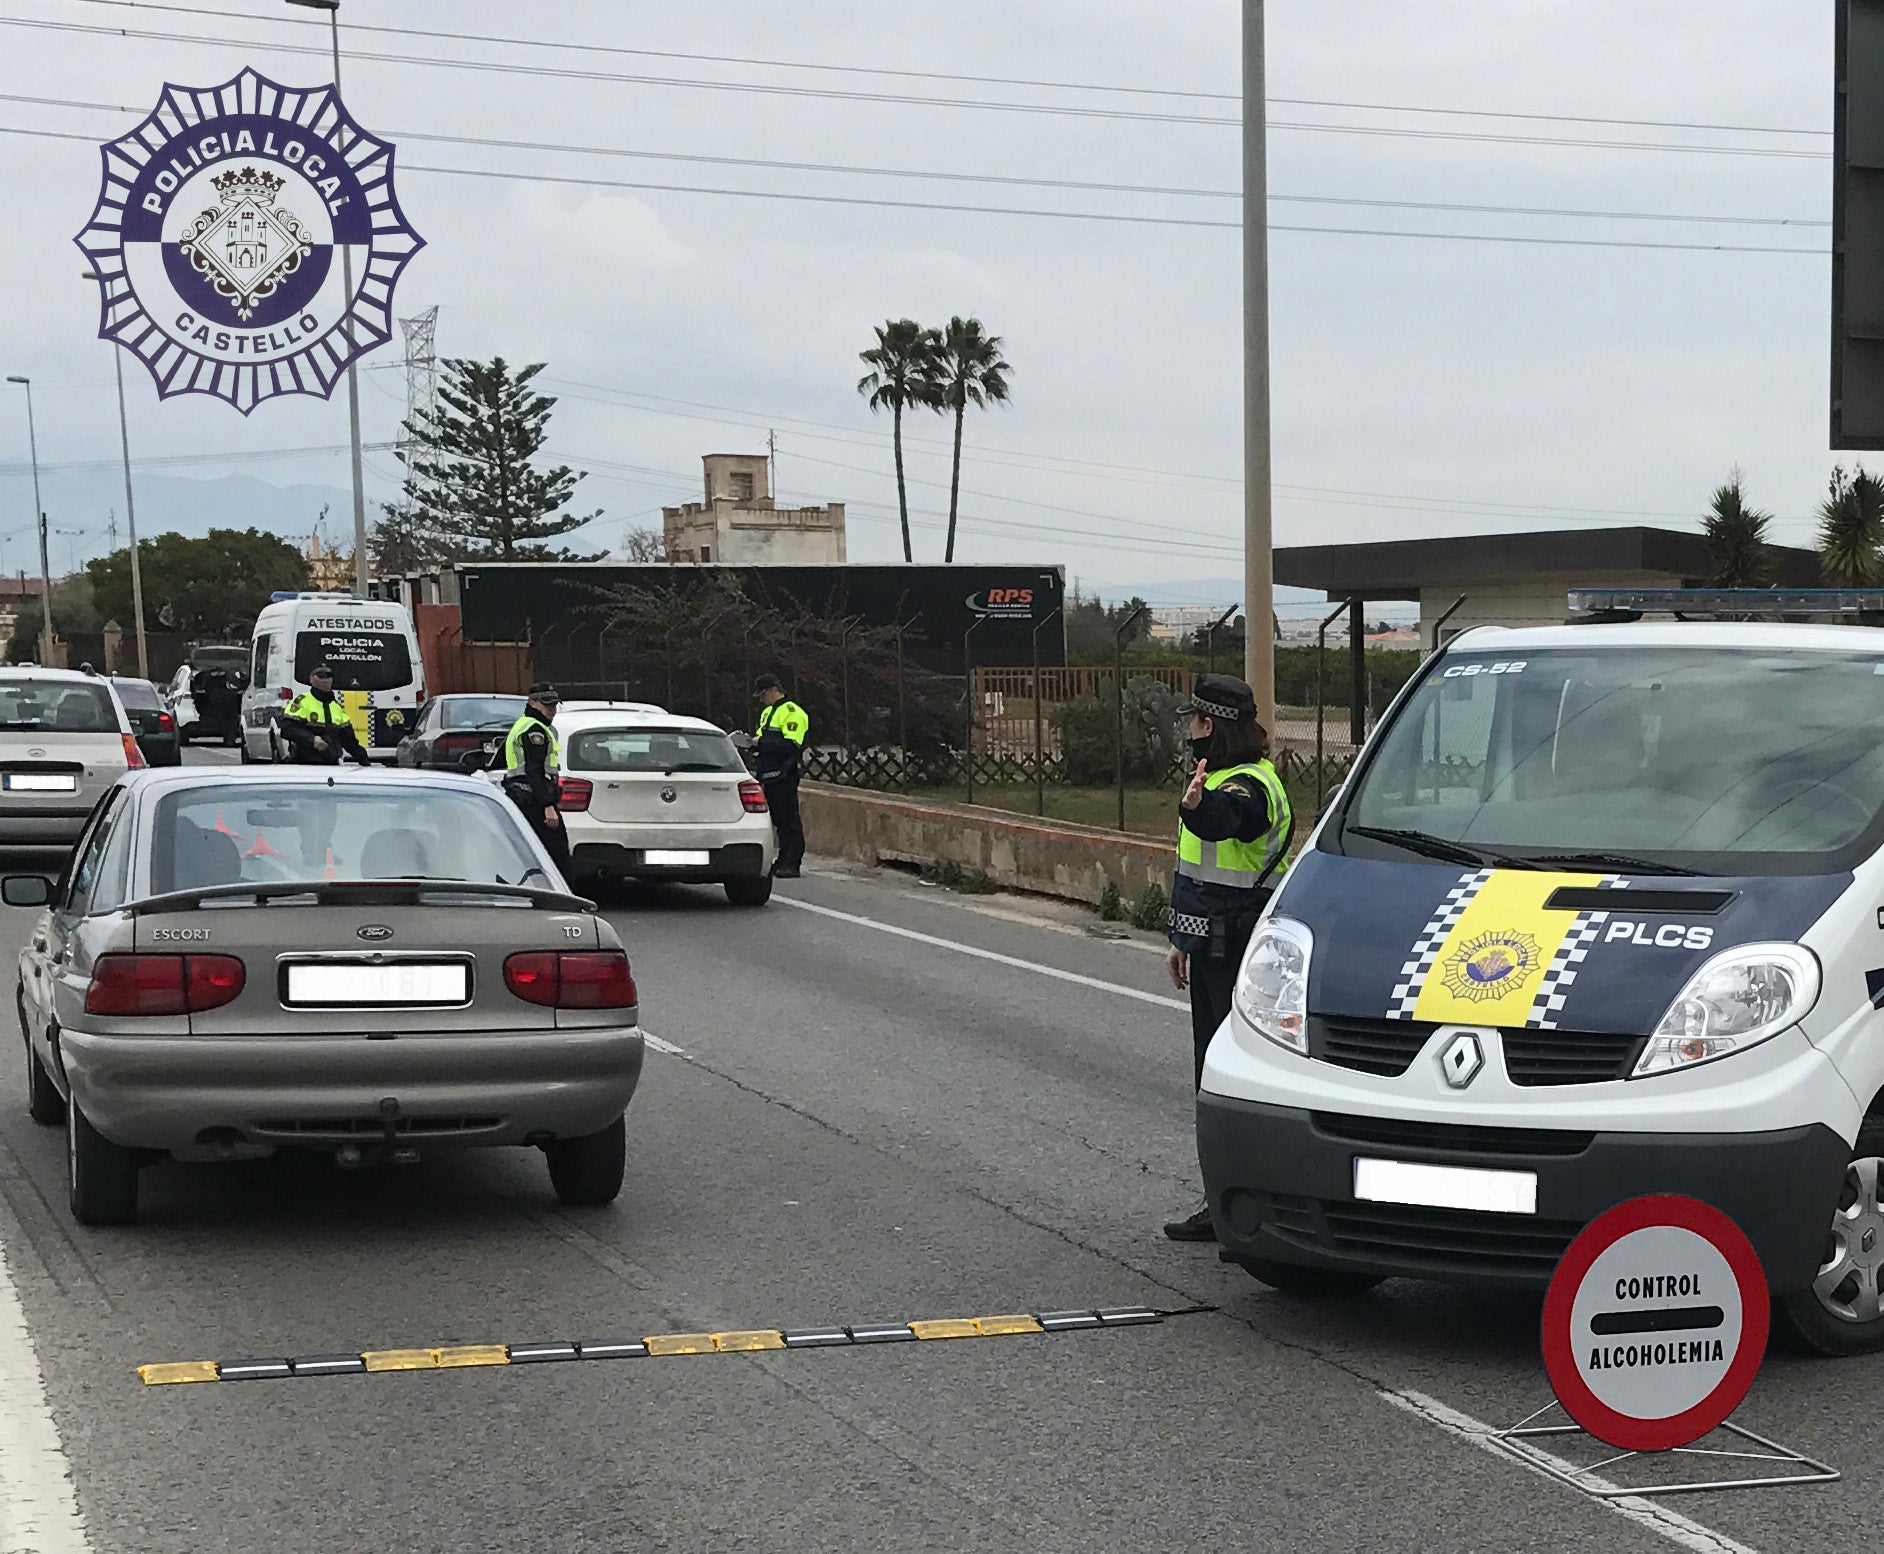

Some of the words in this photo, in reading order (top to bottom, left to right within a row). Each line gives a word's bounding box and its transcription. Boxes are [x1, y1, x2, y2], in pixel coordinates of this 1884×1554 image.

[988, 588, 1034, 604] RPS
[307, 618, 395, 630] ATESTADOS
[320, 637, 384, 648] POLICIA
[1443, 661, 1528, 678] CS-52
[152, 928, 211, 940] ESCORT
[563, 926, 582, 937] TD
[1604, 921, 1714, 950] PLCS
[1615, 1274, 1702, 1300] CONTROL
[1589, 1339, 1724, 1370] ALCOHOLEMIA
